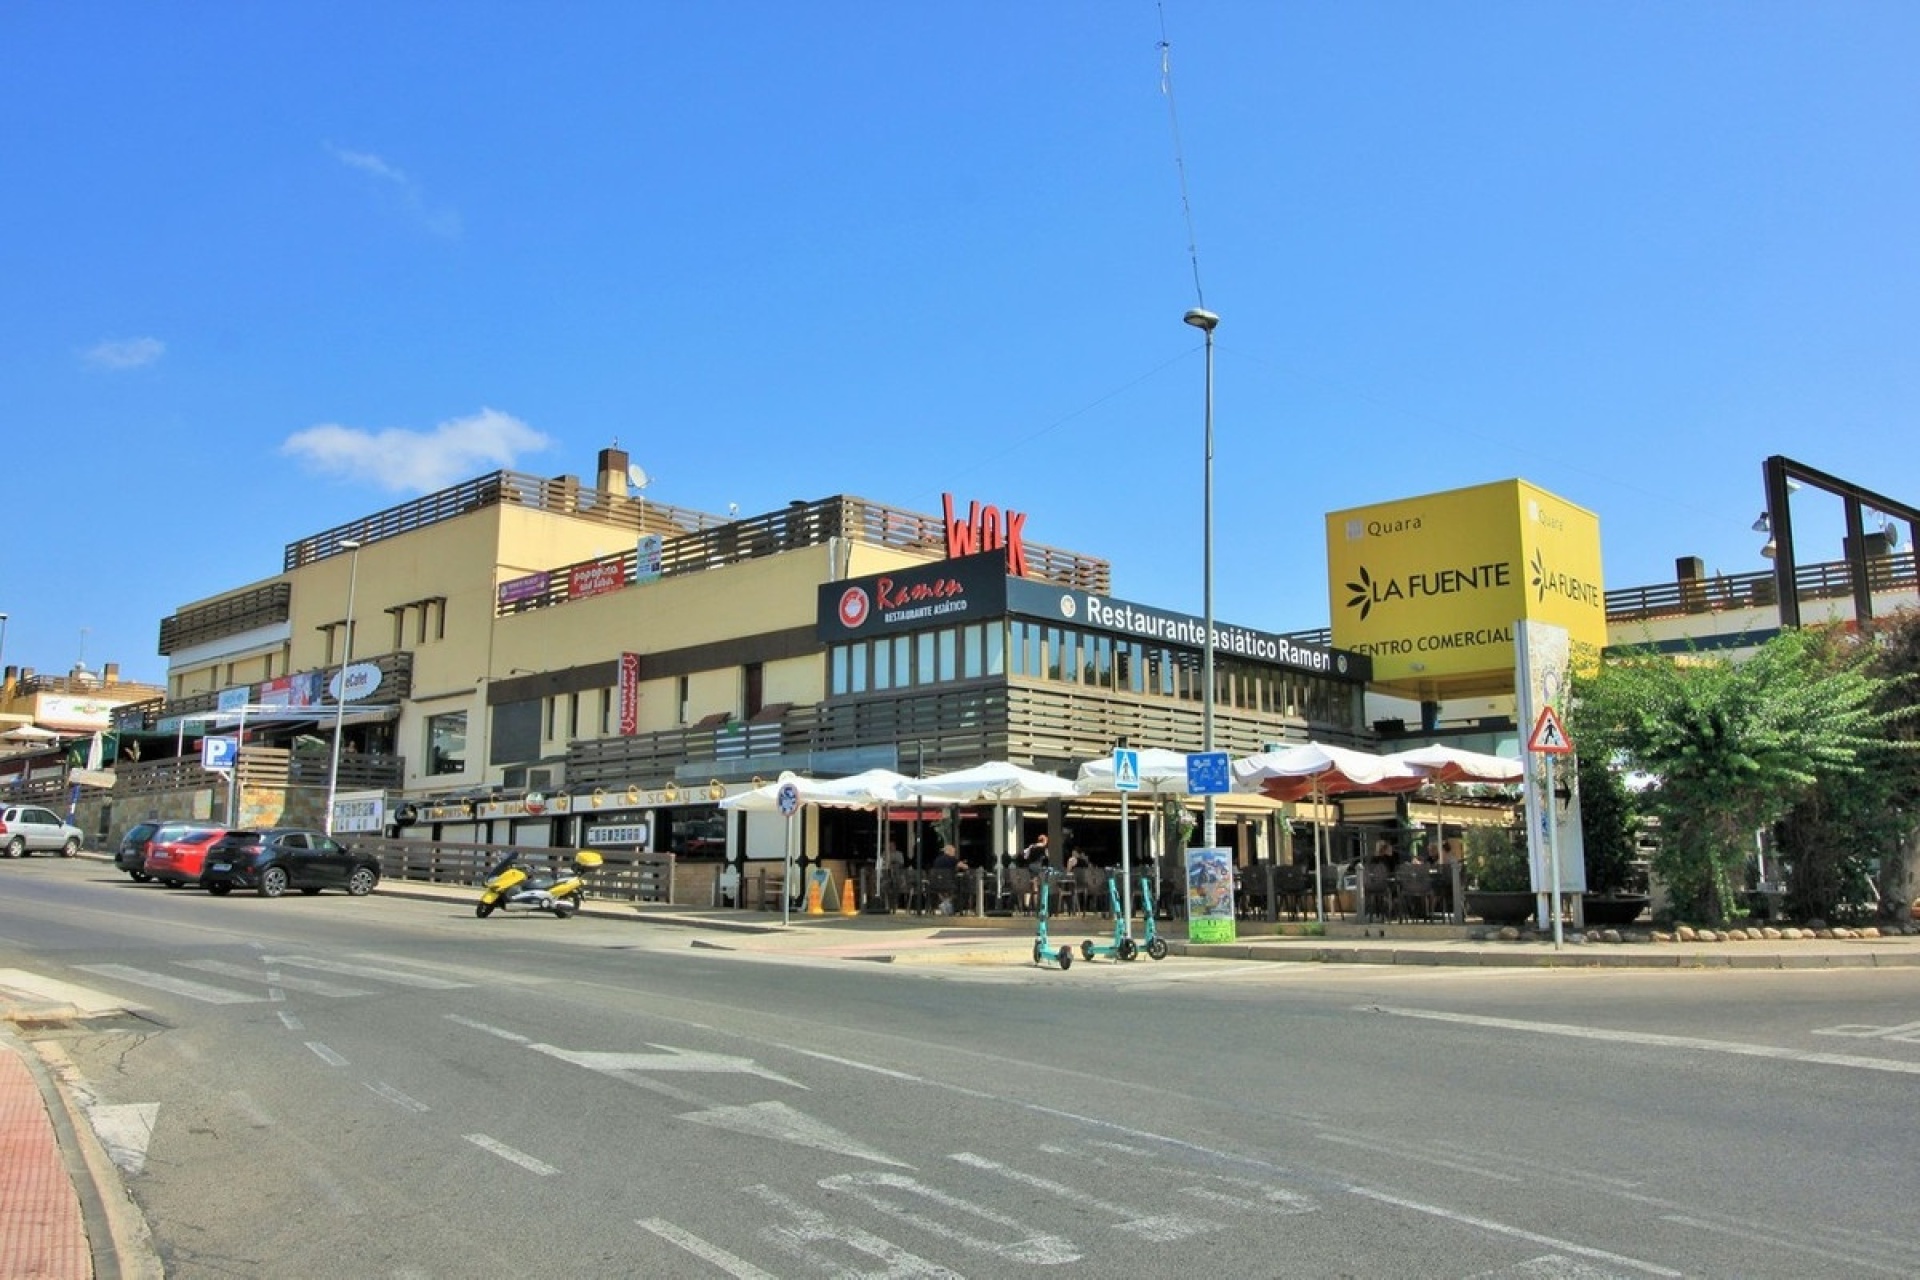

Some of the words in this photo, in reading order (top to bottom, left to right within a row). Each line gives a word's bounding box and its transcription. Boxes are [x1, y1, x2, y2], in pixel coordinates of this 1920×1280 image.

[942, 493, 1028, 577] WOK
[1367, 517, 1422, 537] Quara
[876, 576, 964, 611] Ramen
[1372, 580, 1405, 603] LA
[1409, 562, 1511, 598] FUENTE
[1559, 573, 1600, 608] FUENTE
[885, 604, 933, 624] RESTAURANTE
[934, 598, 968, 617] ASIÁTICO
[1087, 596, 1206, 645] Restaurante
[1212, 625, 1277, 659] asiático
[1279, 639, 1331, 671] Ramen
[1417, 626, 1515, 652] COMERCIAL
[206, 740, 228, 767] P
